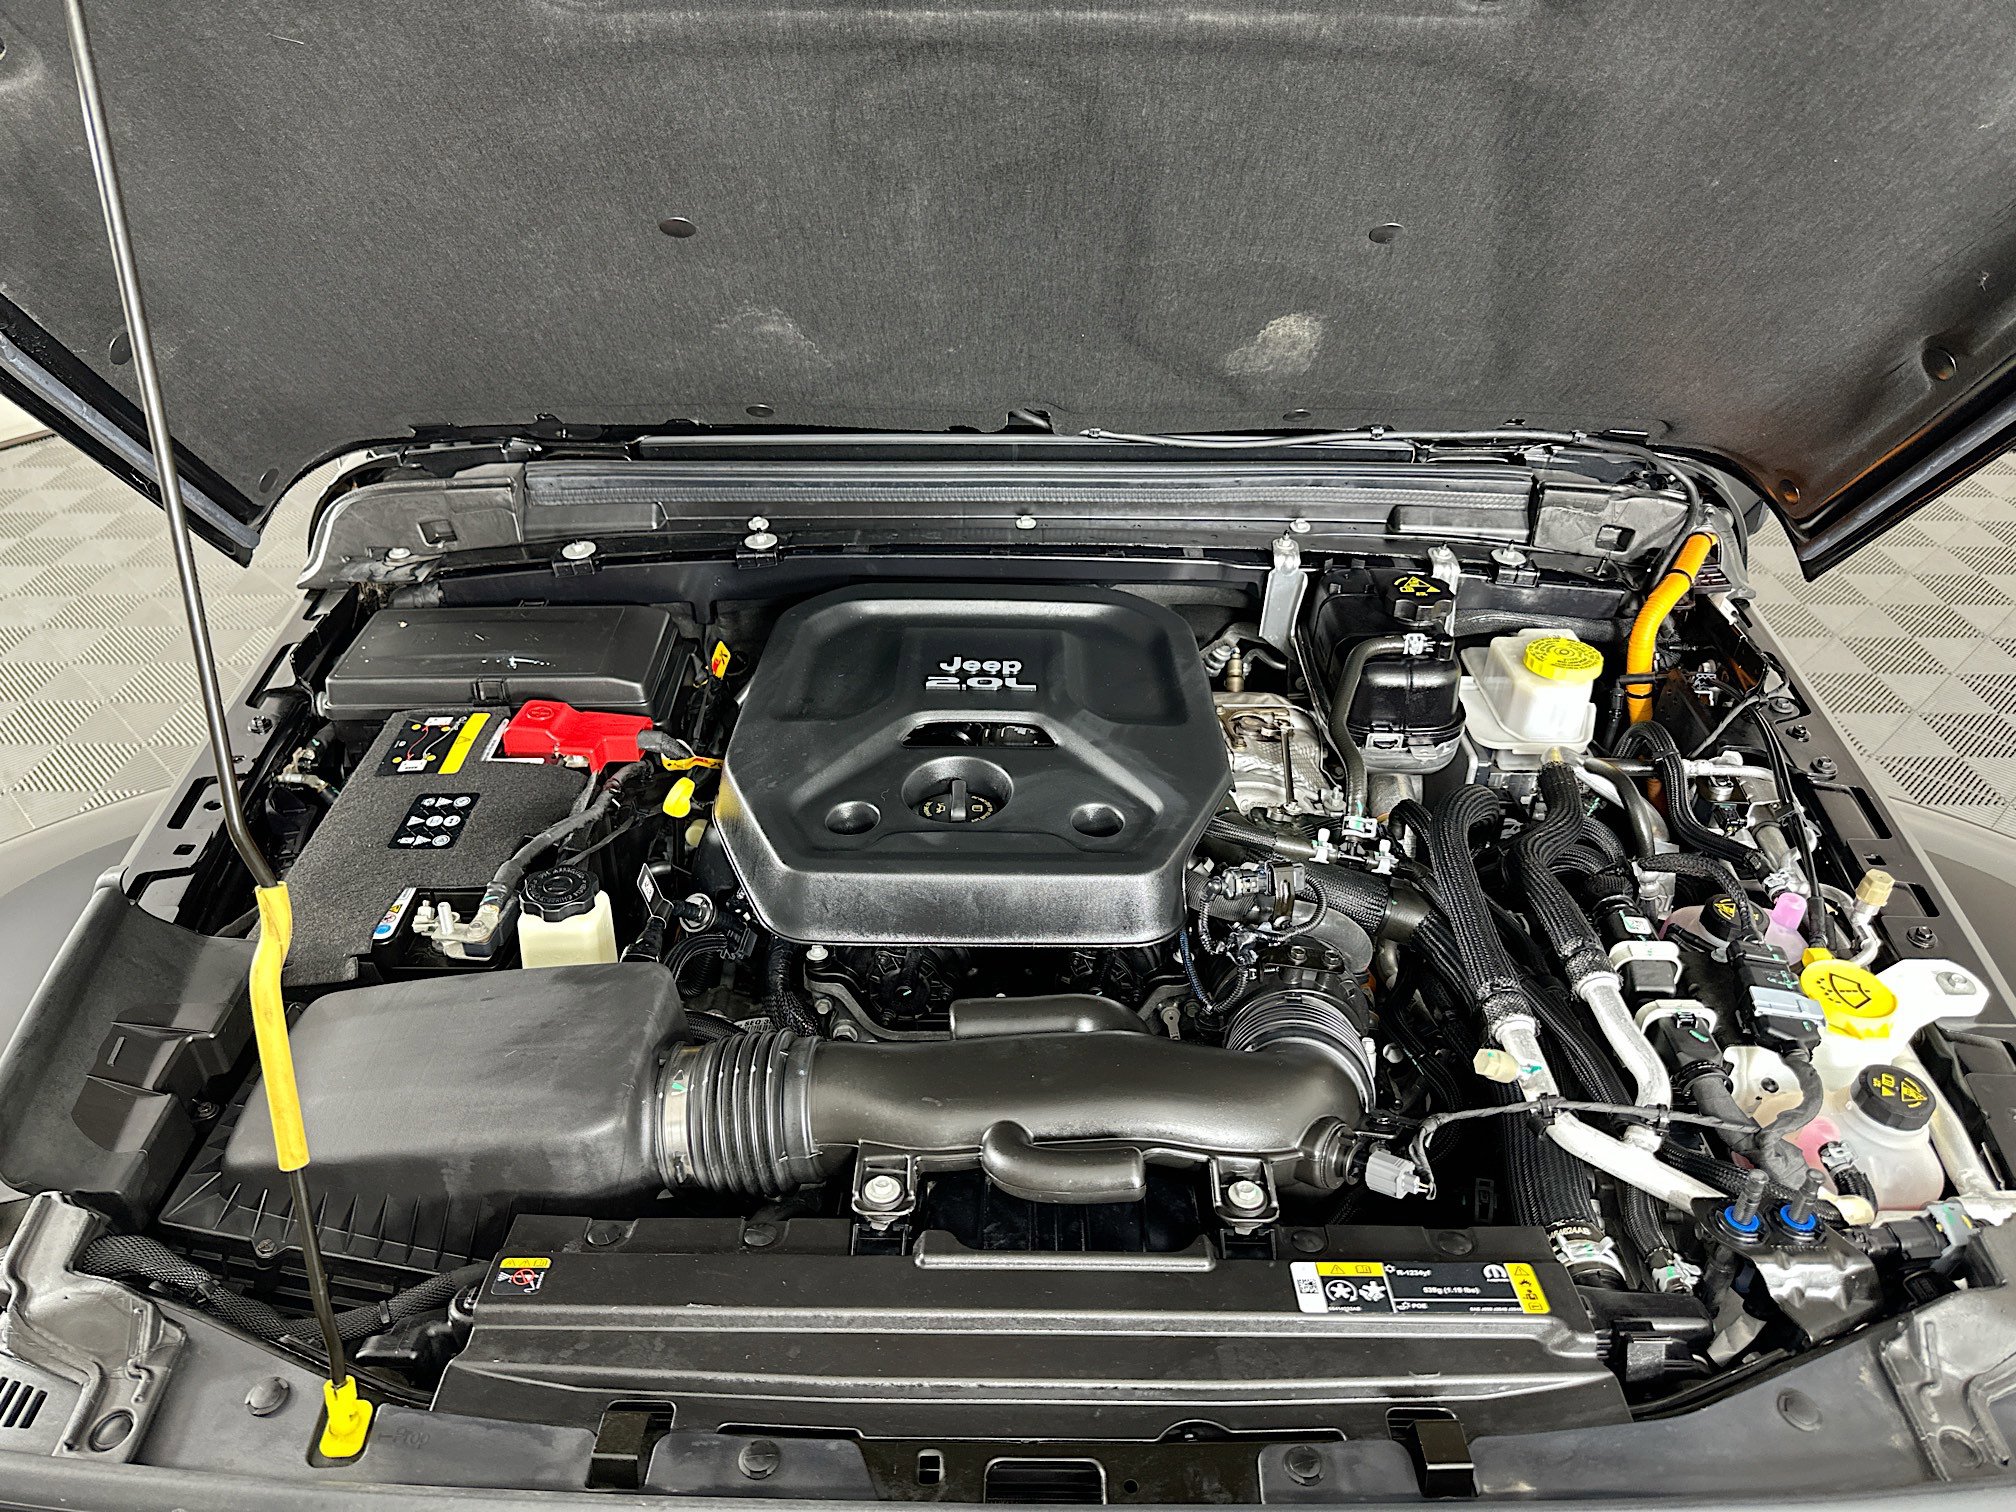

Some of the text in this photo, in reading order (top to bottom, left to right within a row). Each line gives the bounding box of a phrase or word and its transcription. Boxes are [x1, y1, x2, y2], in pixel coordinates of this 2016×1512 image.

[939, 656, 1022, 677] Jeep
[925, 676, 1037, 691] 2.0L
[1396, 1269, 1432, 1277] R-1234yf
